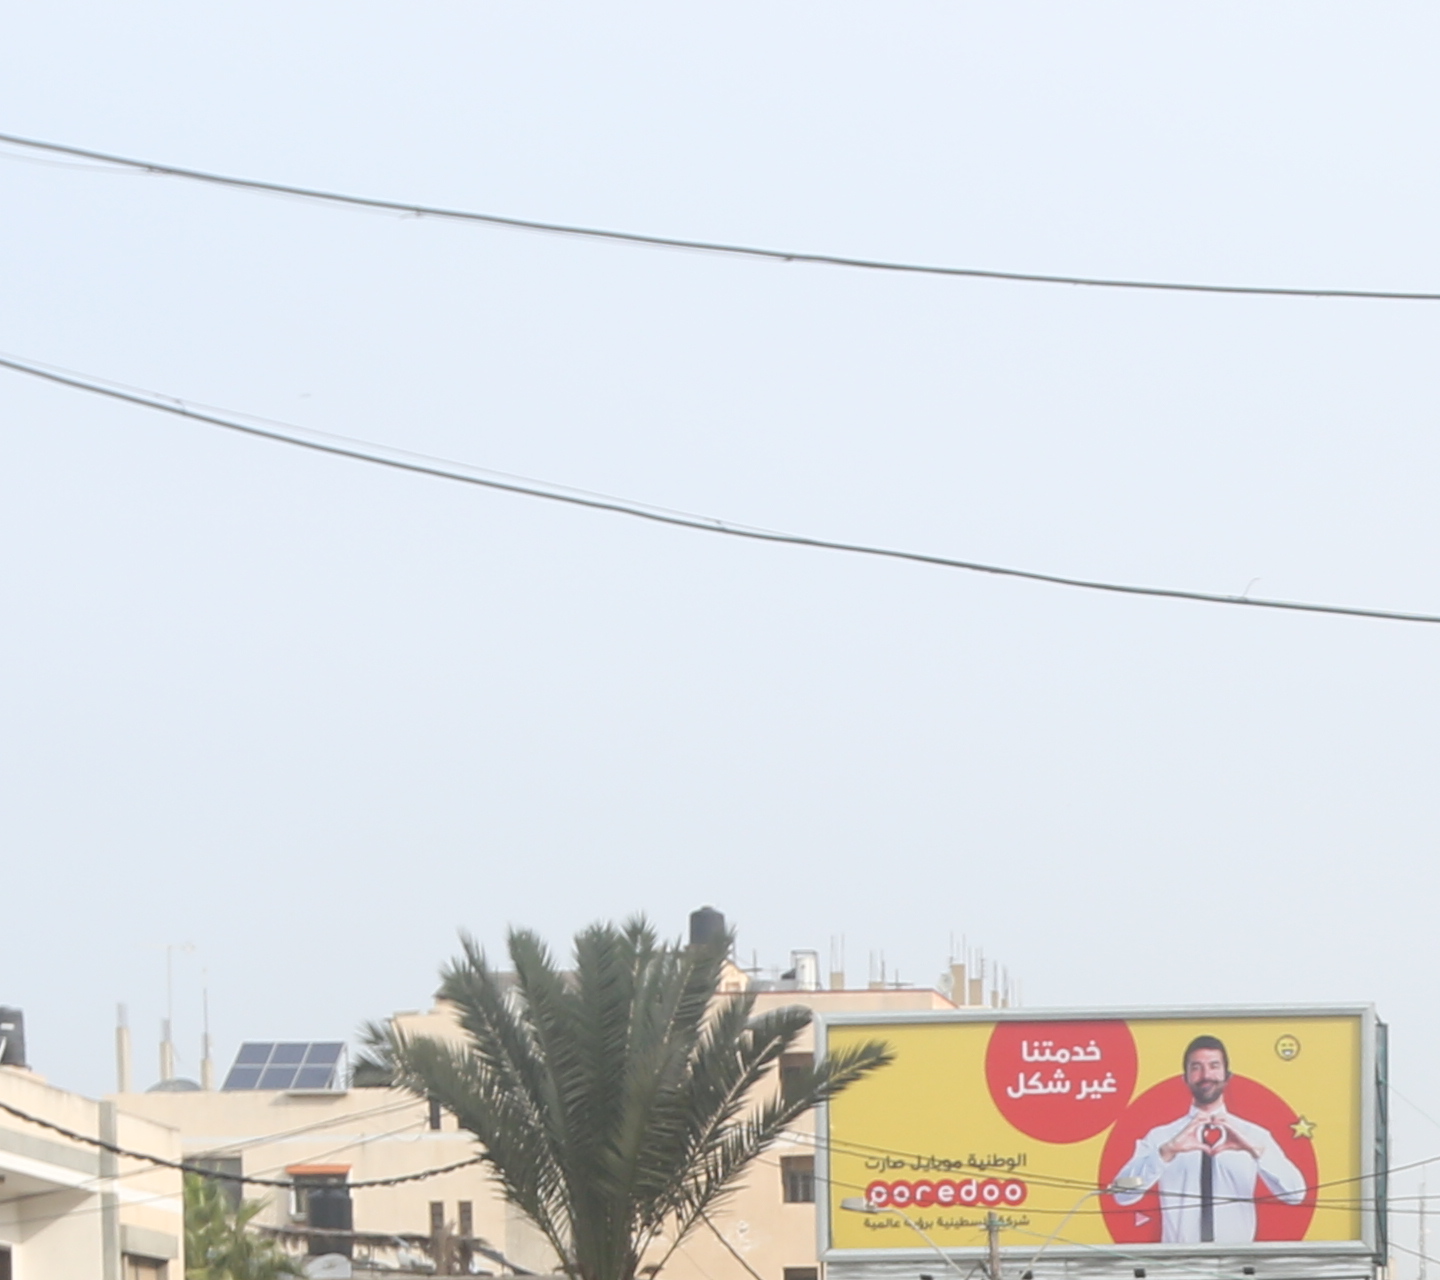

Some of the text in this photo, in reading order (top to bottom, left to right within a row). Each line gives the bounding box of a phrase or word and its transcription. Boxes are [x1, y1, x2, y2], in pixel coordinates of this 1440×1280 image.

[1021, 1039, 1101, 1063] خدمتنا
[1006, 1069, 1117, 1100] غير شكل
[865, 1153, 1027, 1173] الوطنية موبايل صارت
[870, 1179, 1023, 1204] ooredoo
[864, 1216, 901, 1230] عالمية
[937, 1215, 991, 1229] لسطينية
